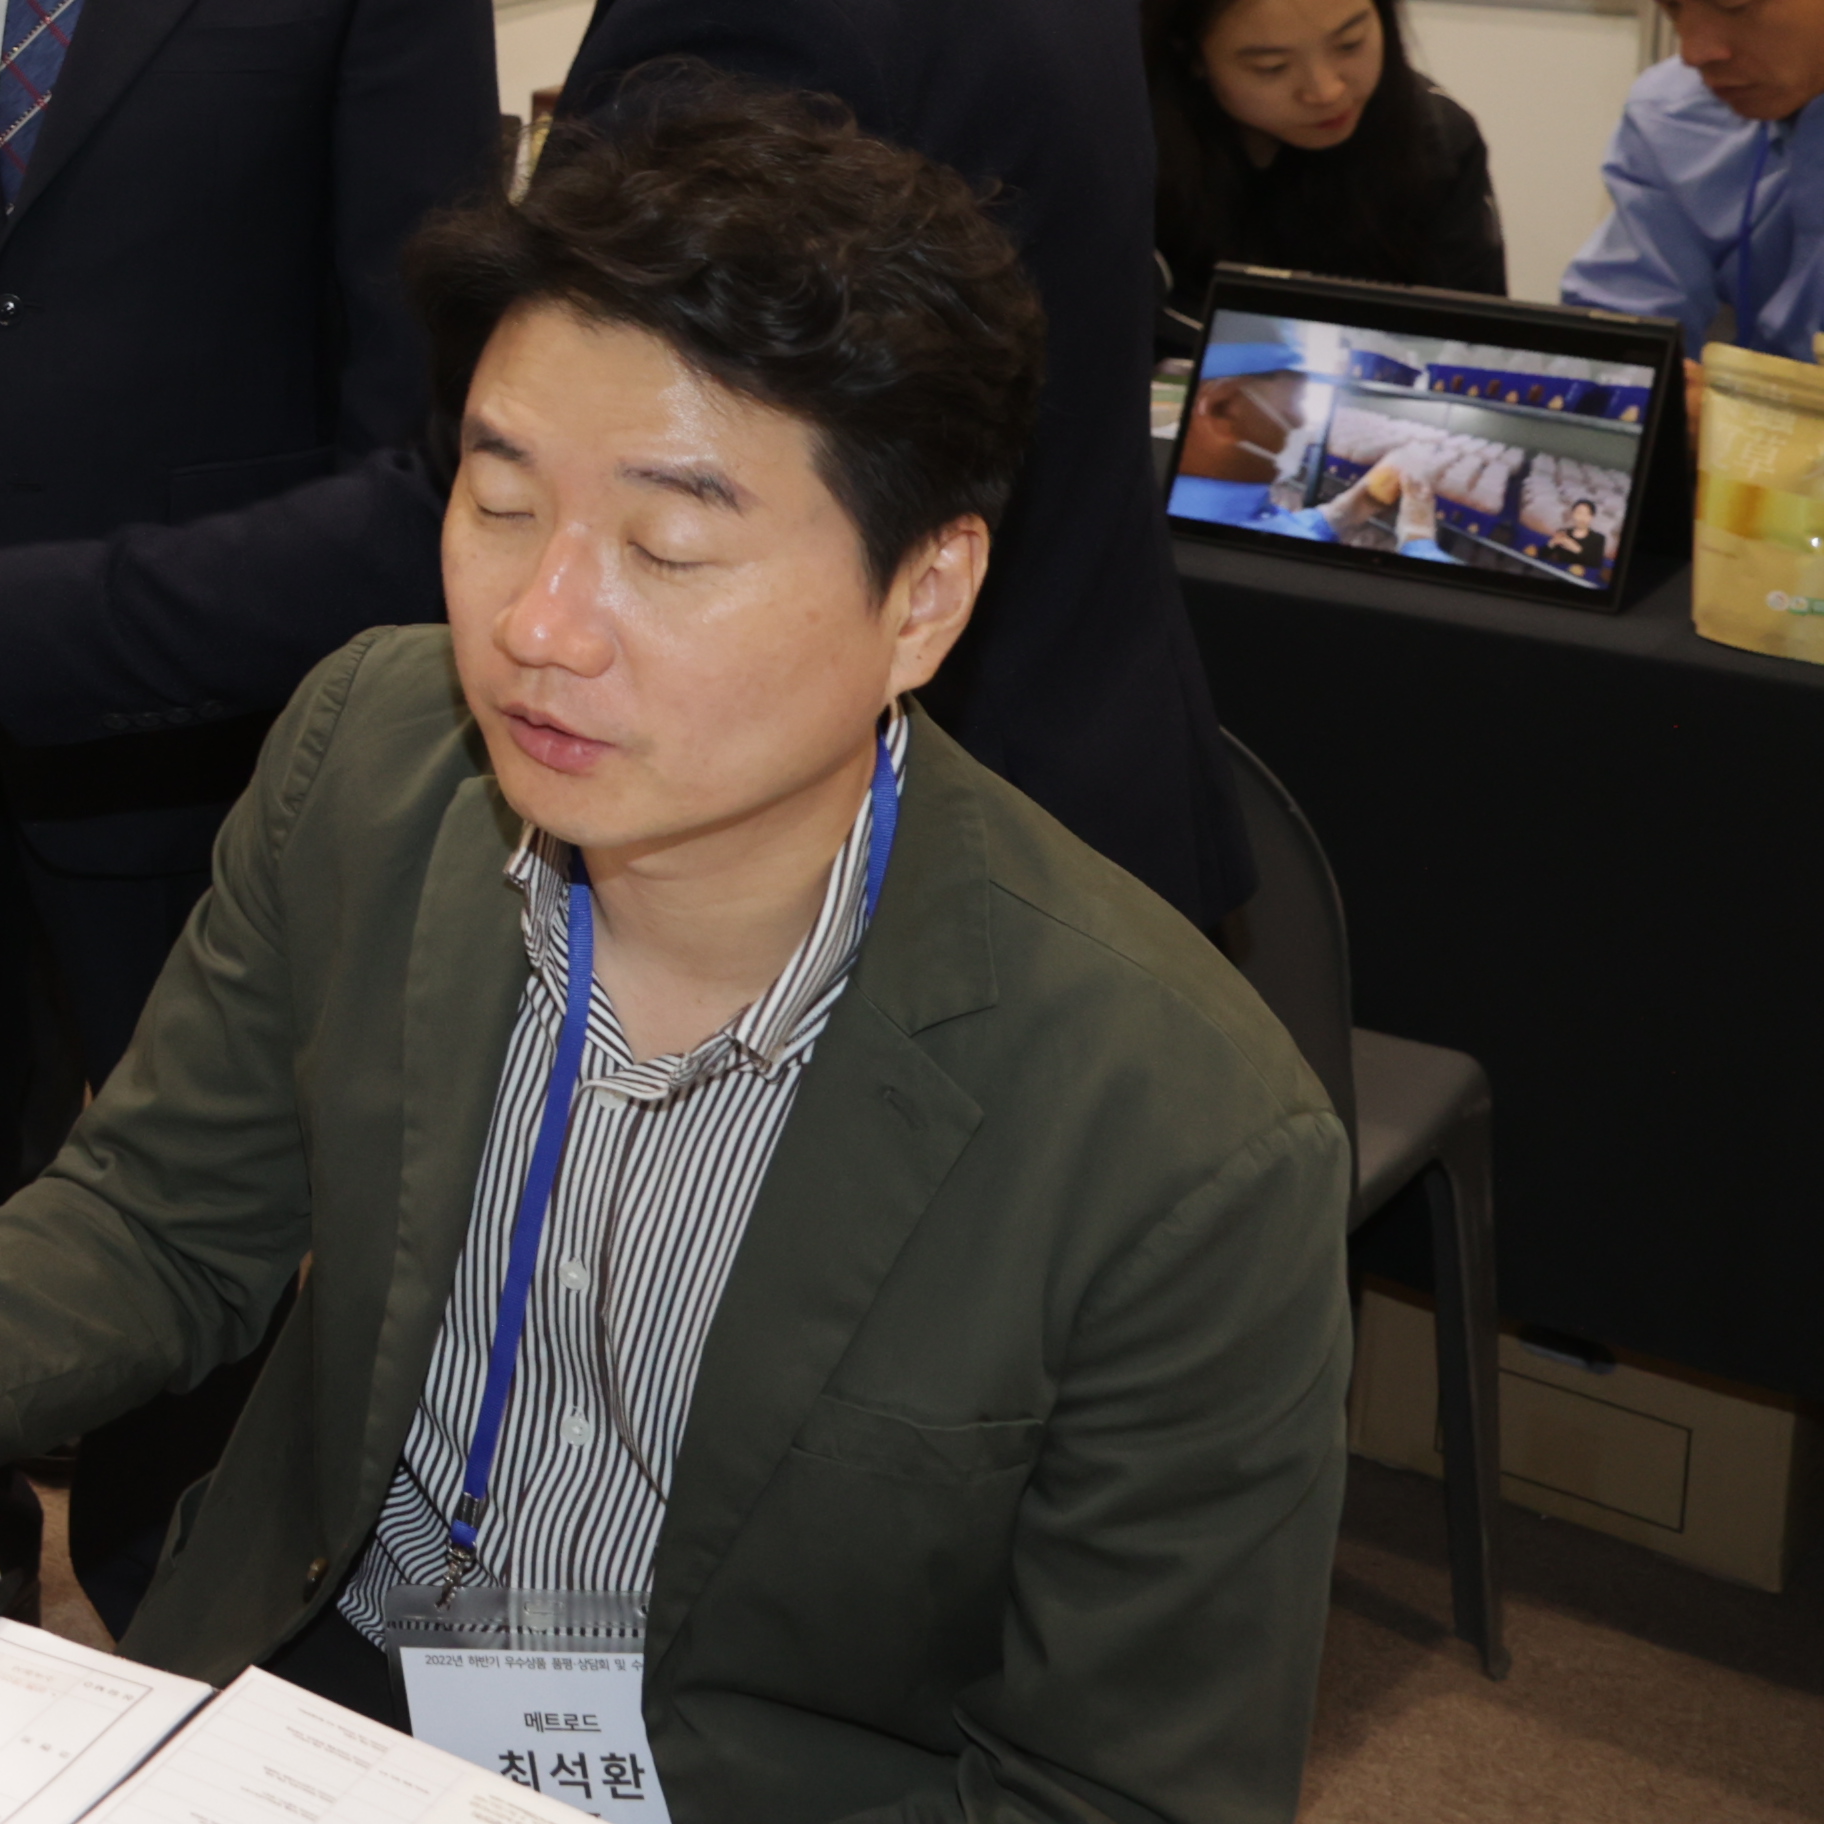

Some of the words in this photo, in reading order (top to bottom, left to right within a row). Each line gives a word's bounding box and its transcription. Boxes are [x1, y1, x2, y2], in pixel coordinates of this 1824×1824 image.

[425, 1654, 464, 1667] 2022년
[468, 1654, 500, 1669] 하반기
[504, 1656, 547, 1671] 우수상품
[615, 1658, 627, 1672] 및
[523, 1710, 602, 1734] 메트로드
